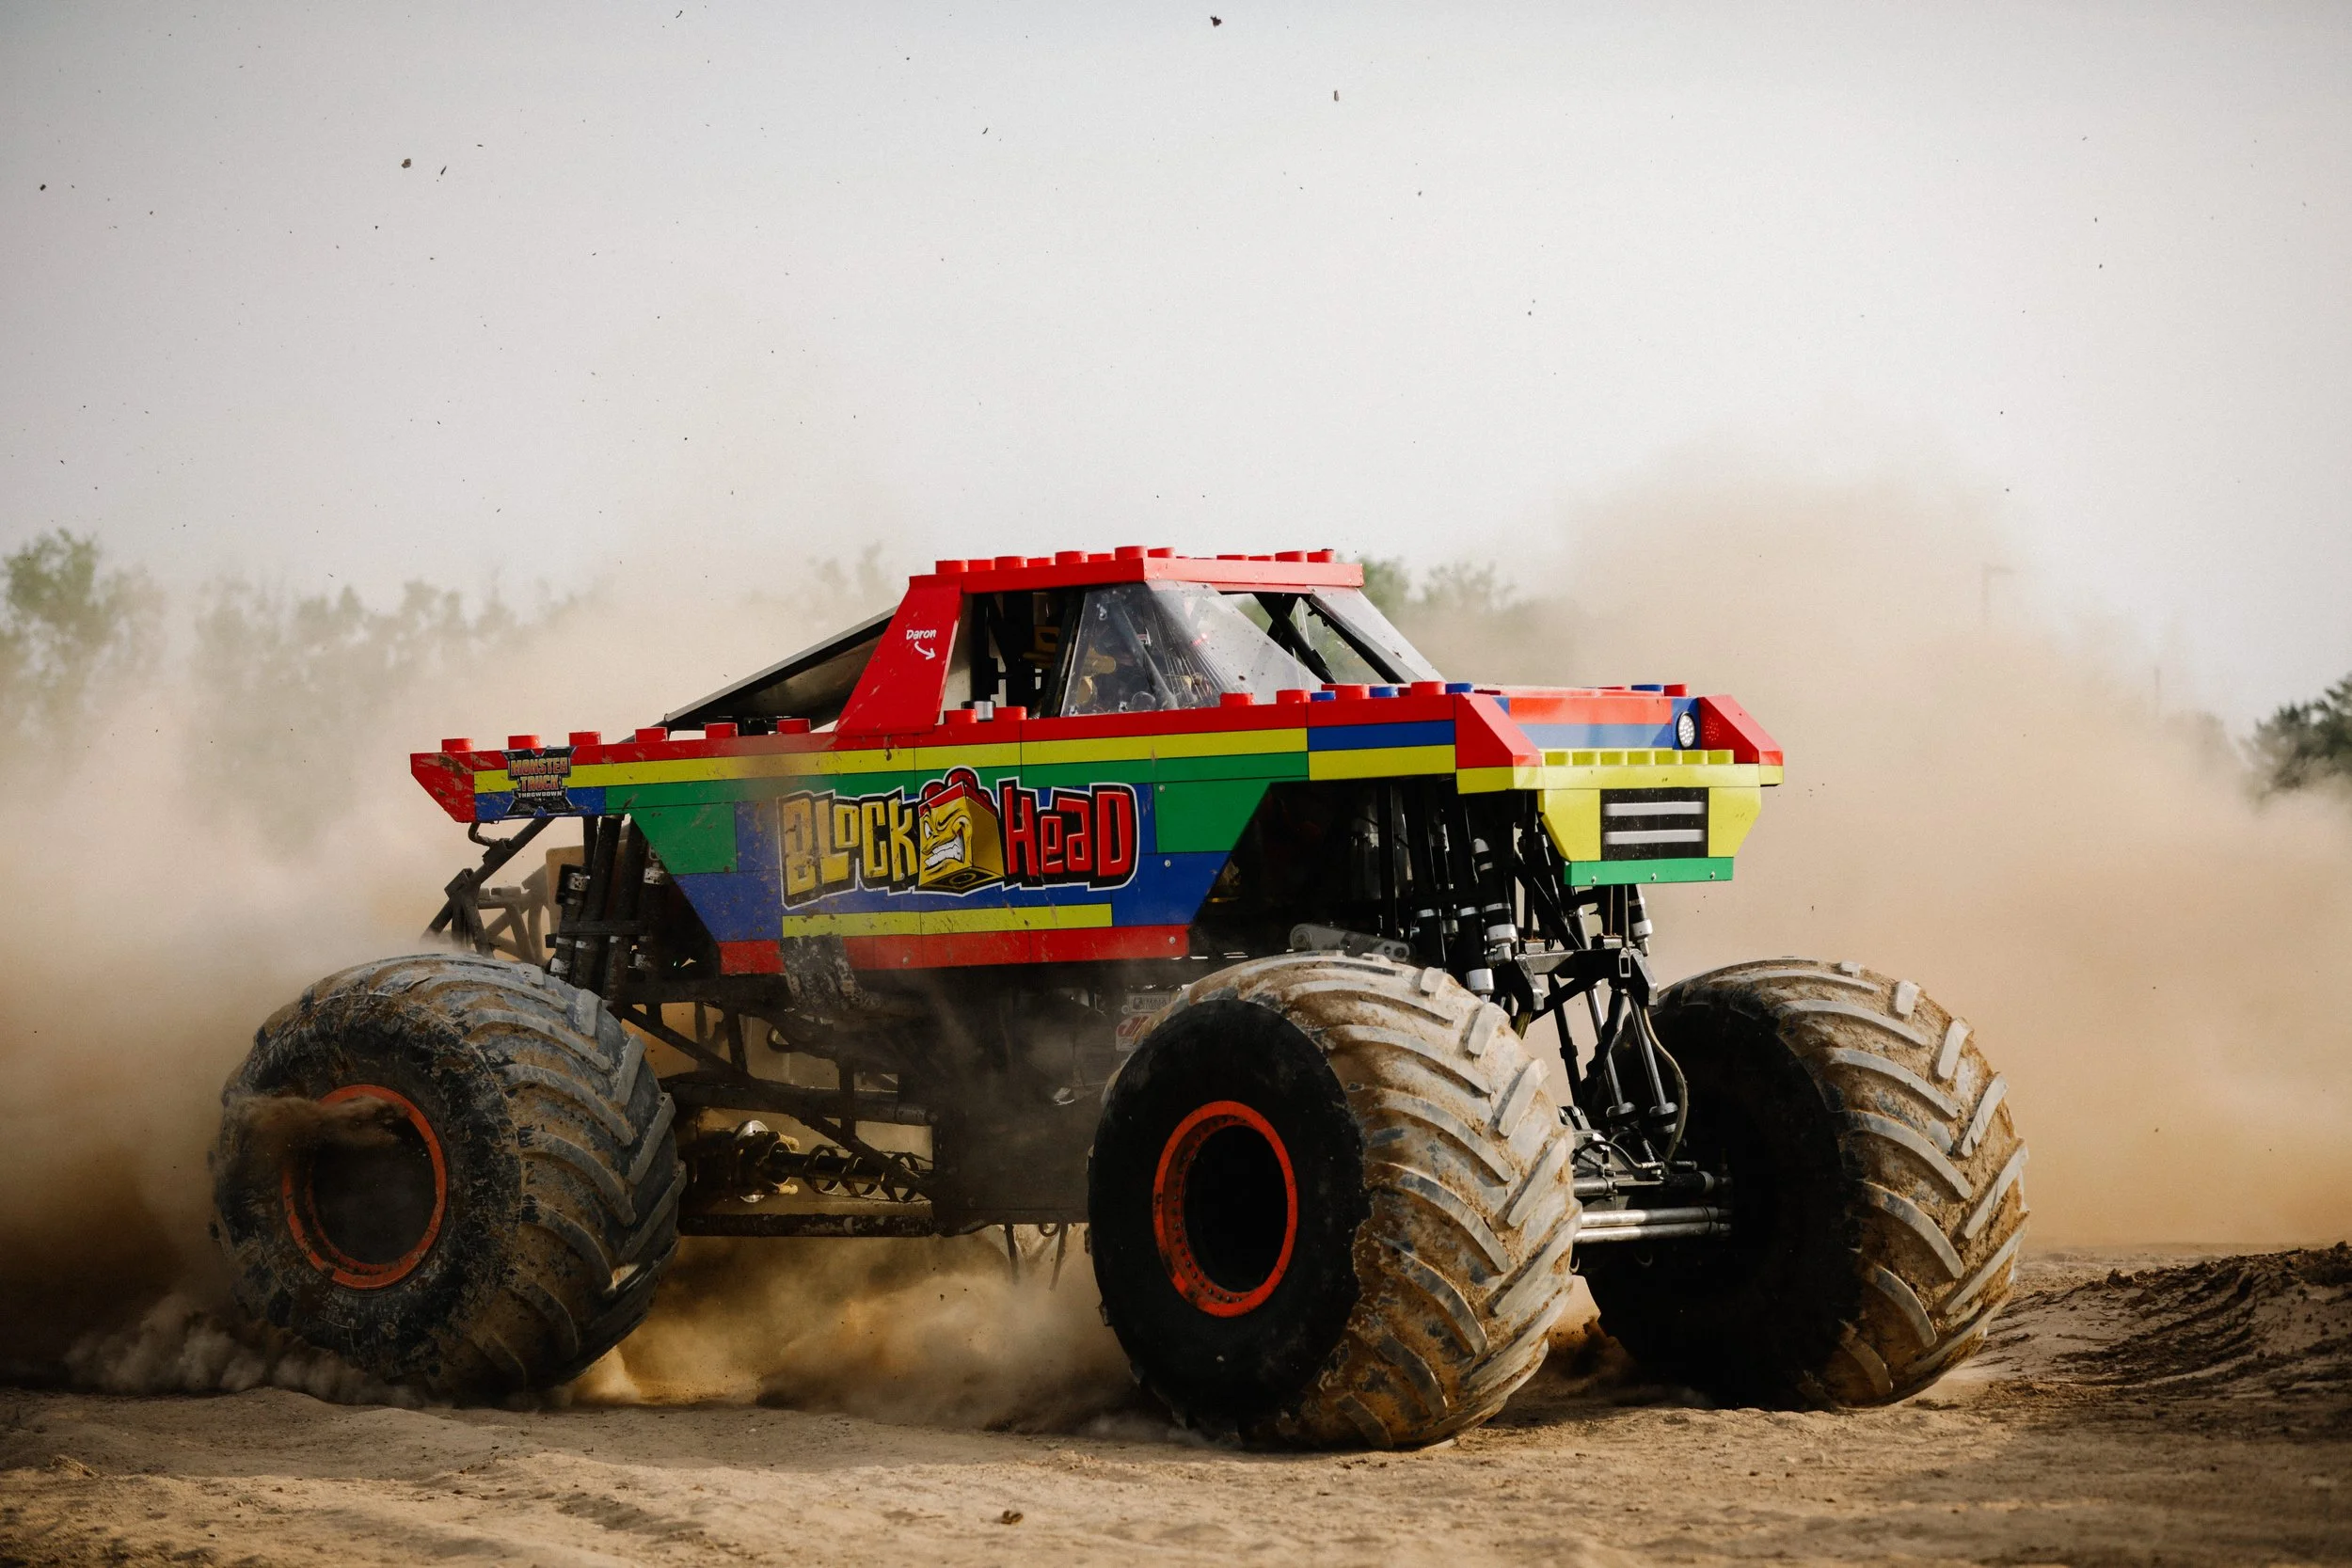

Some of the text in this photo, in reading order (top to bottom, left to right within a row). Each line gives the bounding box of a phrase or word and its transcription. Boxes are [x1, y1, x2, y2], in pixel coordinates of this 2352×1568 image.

[906, 629, 936, 640] Daron
[511, 757, 568, 776] MONSTER
[520, 775, 559, 791] TRUCK
[518, 790, 563, 799] THROWDOWN
